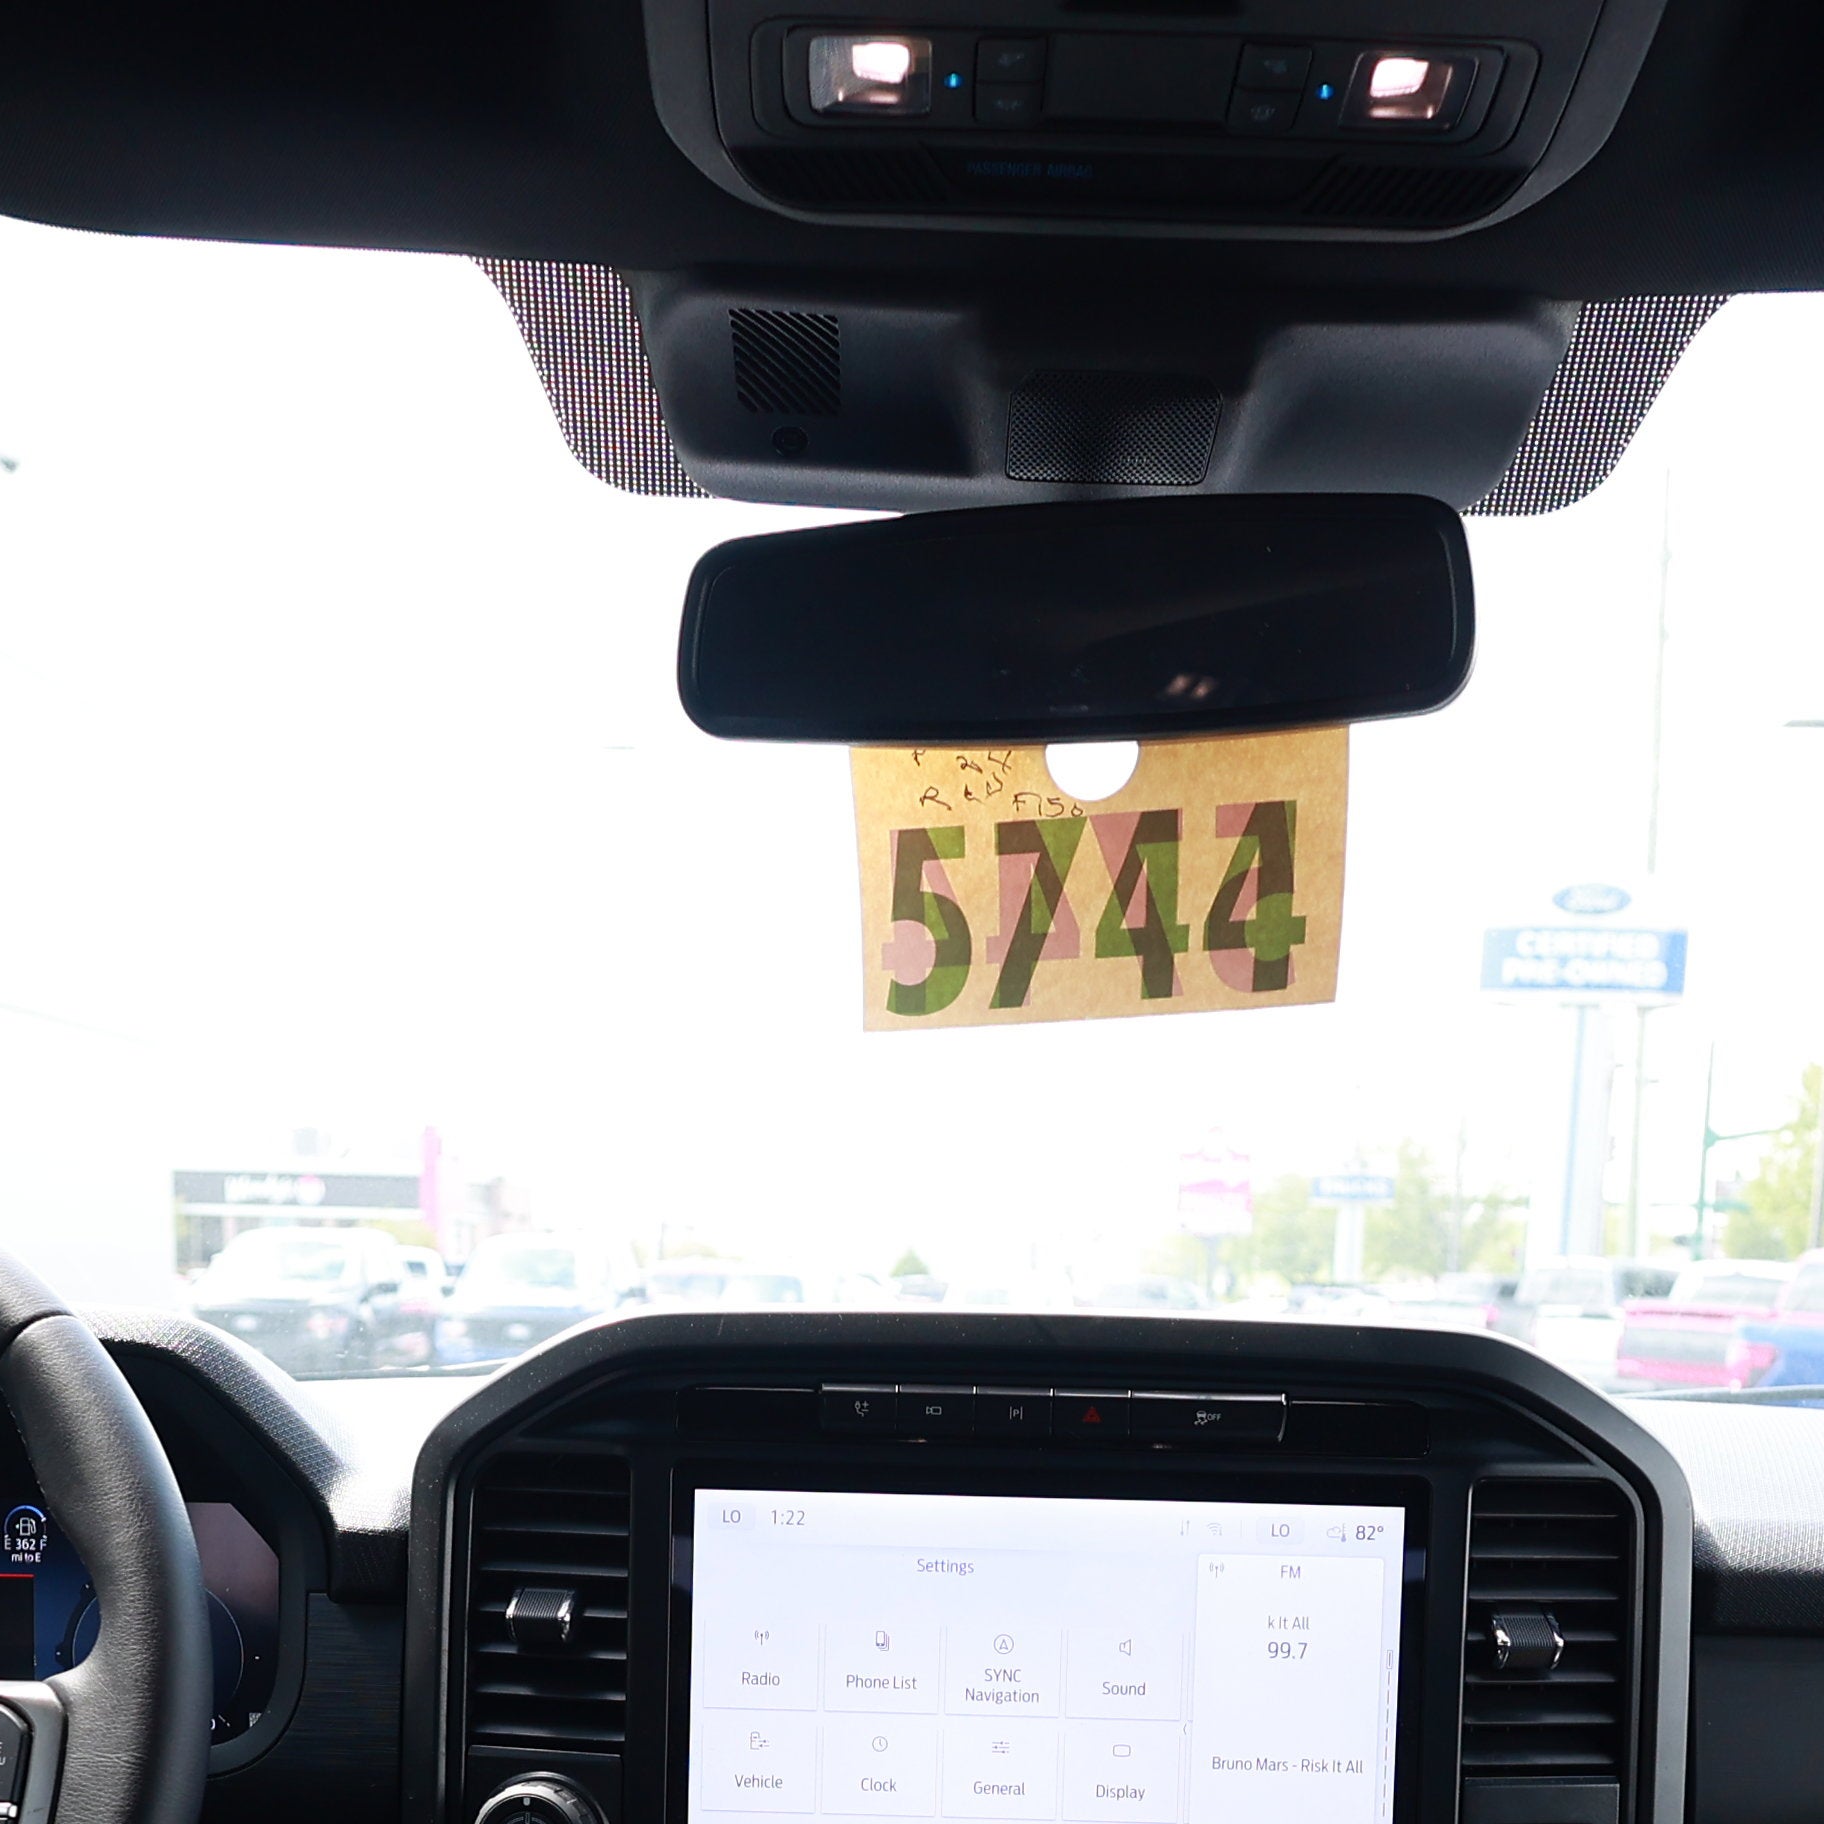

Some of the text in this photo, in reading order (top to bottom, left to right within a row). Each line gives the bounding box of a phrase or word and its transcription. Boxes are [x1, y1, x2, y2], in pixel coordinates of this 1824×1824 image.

[885, 800, 1307, 1018] 5744
[1207, 1413, 1221, 1421] OFF
[722, 1509, 805, 1526] LO 1:22
[1271, 1523, 1385, 1541] LO 82°
[15, 1538, 36, 1551] 362
[11, 1553, 23, 1562] mi
[24, 1553, 34, 1562] to
[917, 1558, 975, 1576] Settings
[1280, 1564, 1301, 1579] FM
[1267, 1615, 1311, 1631] k It All
[1267, 1641, 1308, 1660] 99.7
[741, 1671, 781, 1686] Radio
[846, 1674, 918, 1691] Phone List
[984, 1668, 1022, 1683] SYNC
[965, 1687, 1040, 1705] Navigation
[1102, 1681, 1146, 1696] Sound
[1211, 1756, 1253, 1772] Bruno
[1255, 1757, 1289, 1773] Mars
[1301, 1758, 1328, 1774] Risk
[1331, 1759, 1341, 1774] It
[1345, 1759, 1364, 1774] All
[734, 1773, 783, 1789] Vehicle
[860, 1777, 897, 1793] Clock
[973, 1780, 1025, 1796] General
[1095, 1784, 1146, 1802] Display
